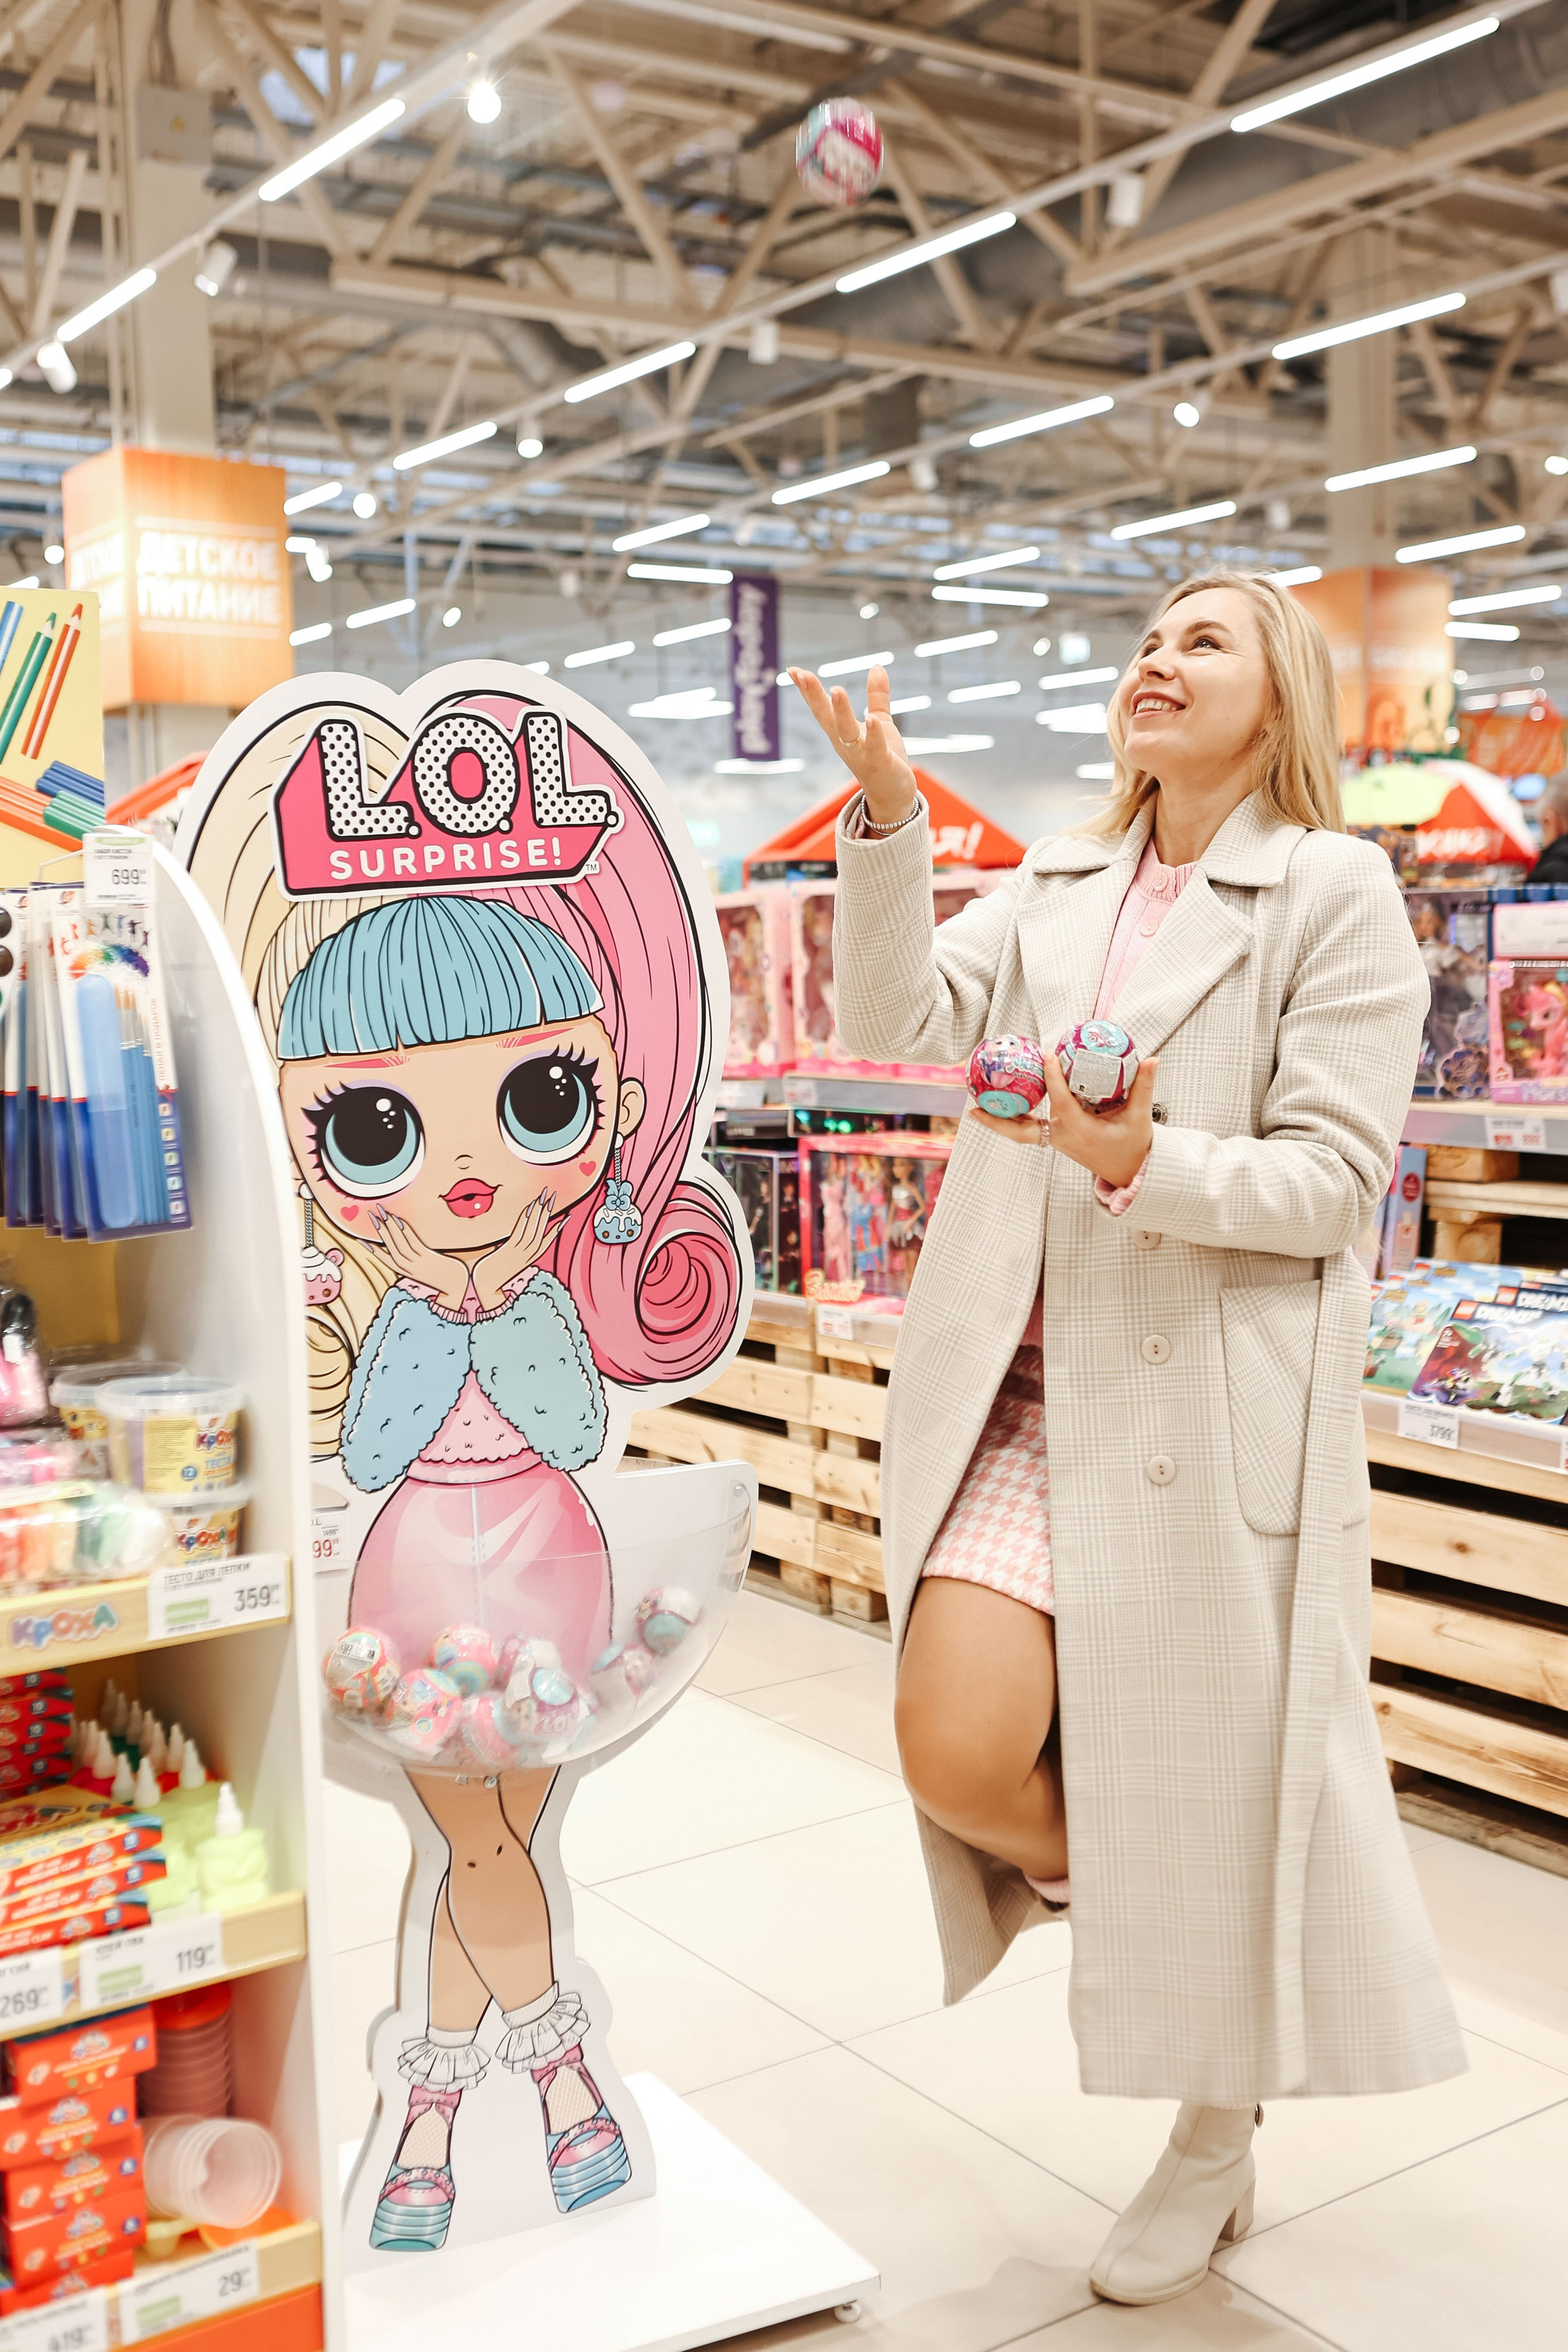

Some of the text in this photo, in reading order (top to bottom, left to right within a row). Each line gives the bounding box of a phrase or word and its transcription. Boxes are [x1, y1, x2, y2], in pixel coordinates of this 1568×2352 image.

[136, 530, 281, 579] ДЕТСКОЕ
[137, 577, 281, 624] ПИТАНИЕ
[329, 837, 562, 880] SURPRISE!
[585, 863, 598, 872] TM
[112, 869, 138, 885] 699
[149, 998, 160, 1041] ПОДАРОК
[156, 1052, 166, 1081] ПЕНАЛ
[183, 1466, 197, 1477] 12
[164, 1572, 193, 1586] ТЕСТО
[195, 1568, 215, 1581] ДЛЯ
[217, 1562, 250, 1577] ЛЕПКИ
[234, 1586, 271, 1612] 359
[176, 1947, 205, 1973] 119
[0, 1989, 39, 2018] 269
[217, 2271, 242, 2297] 29
